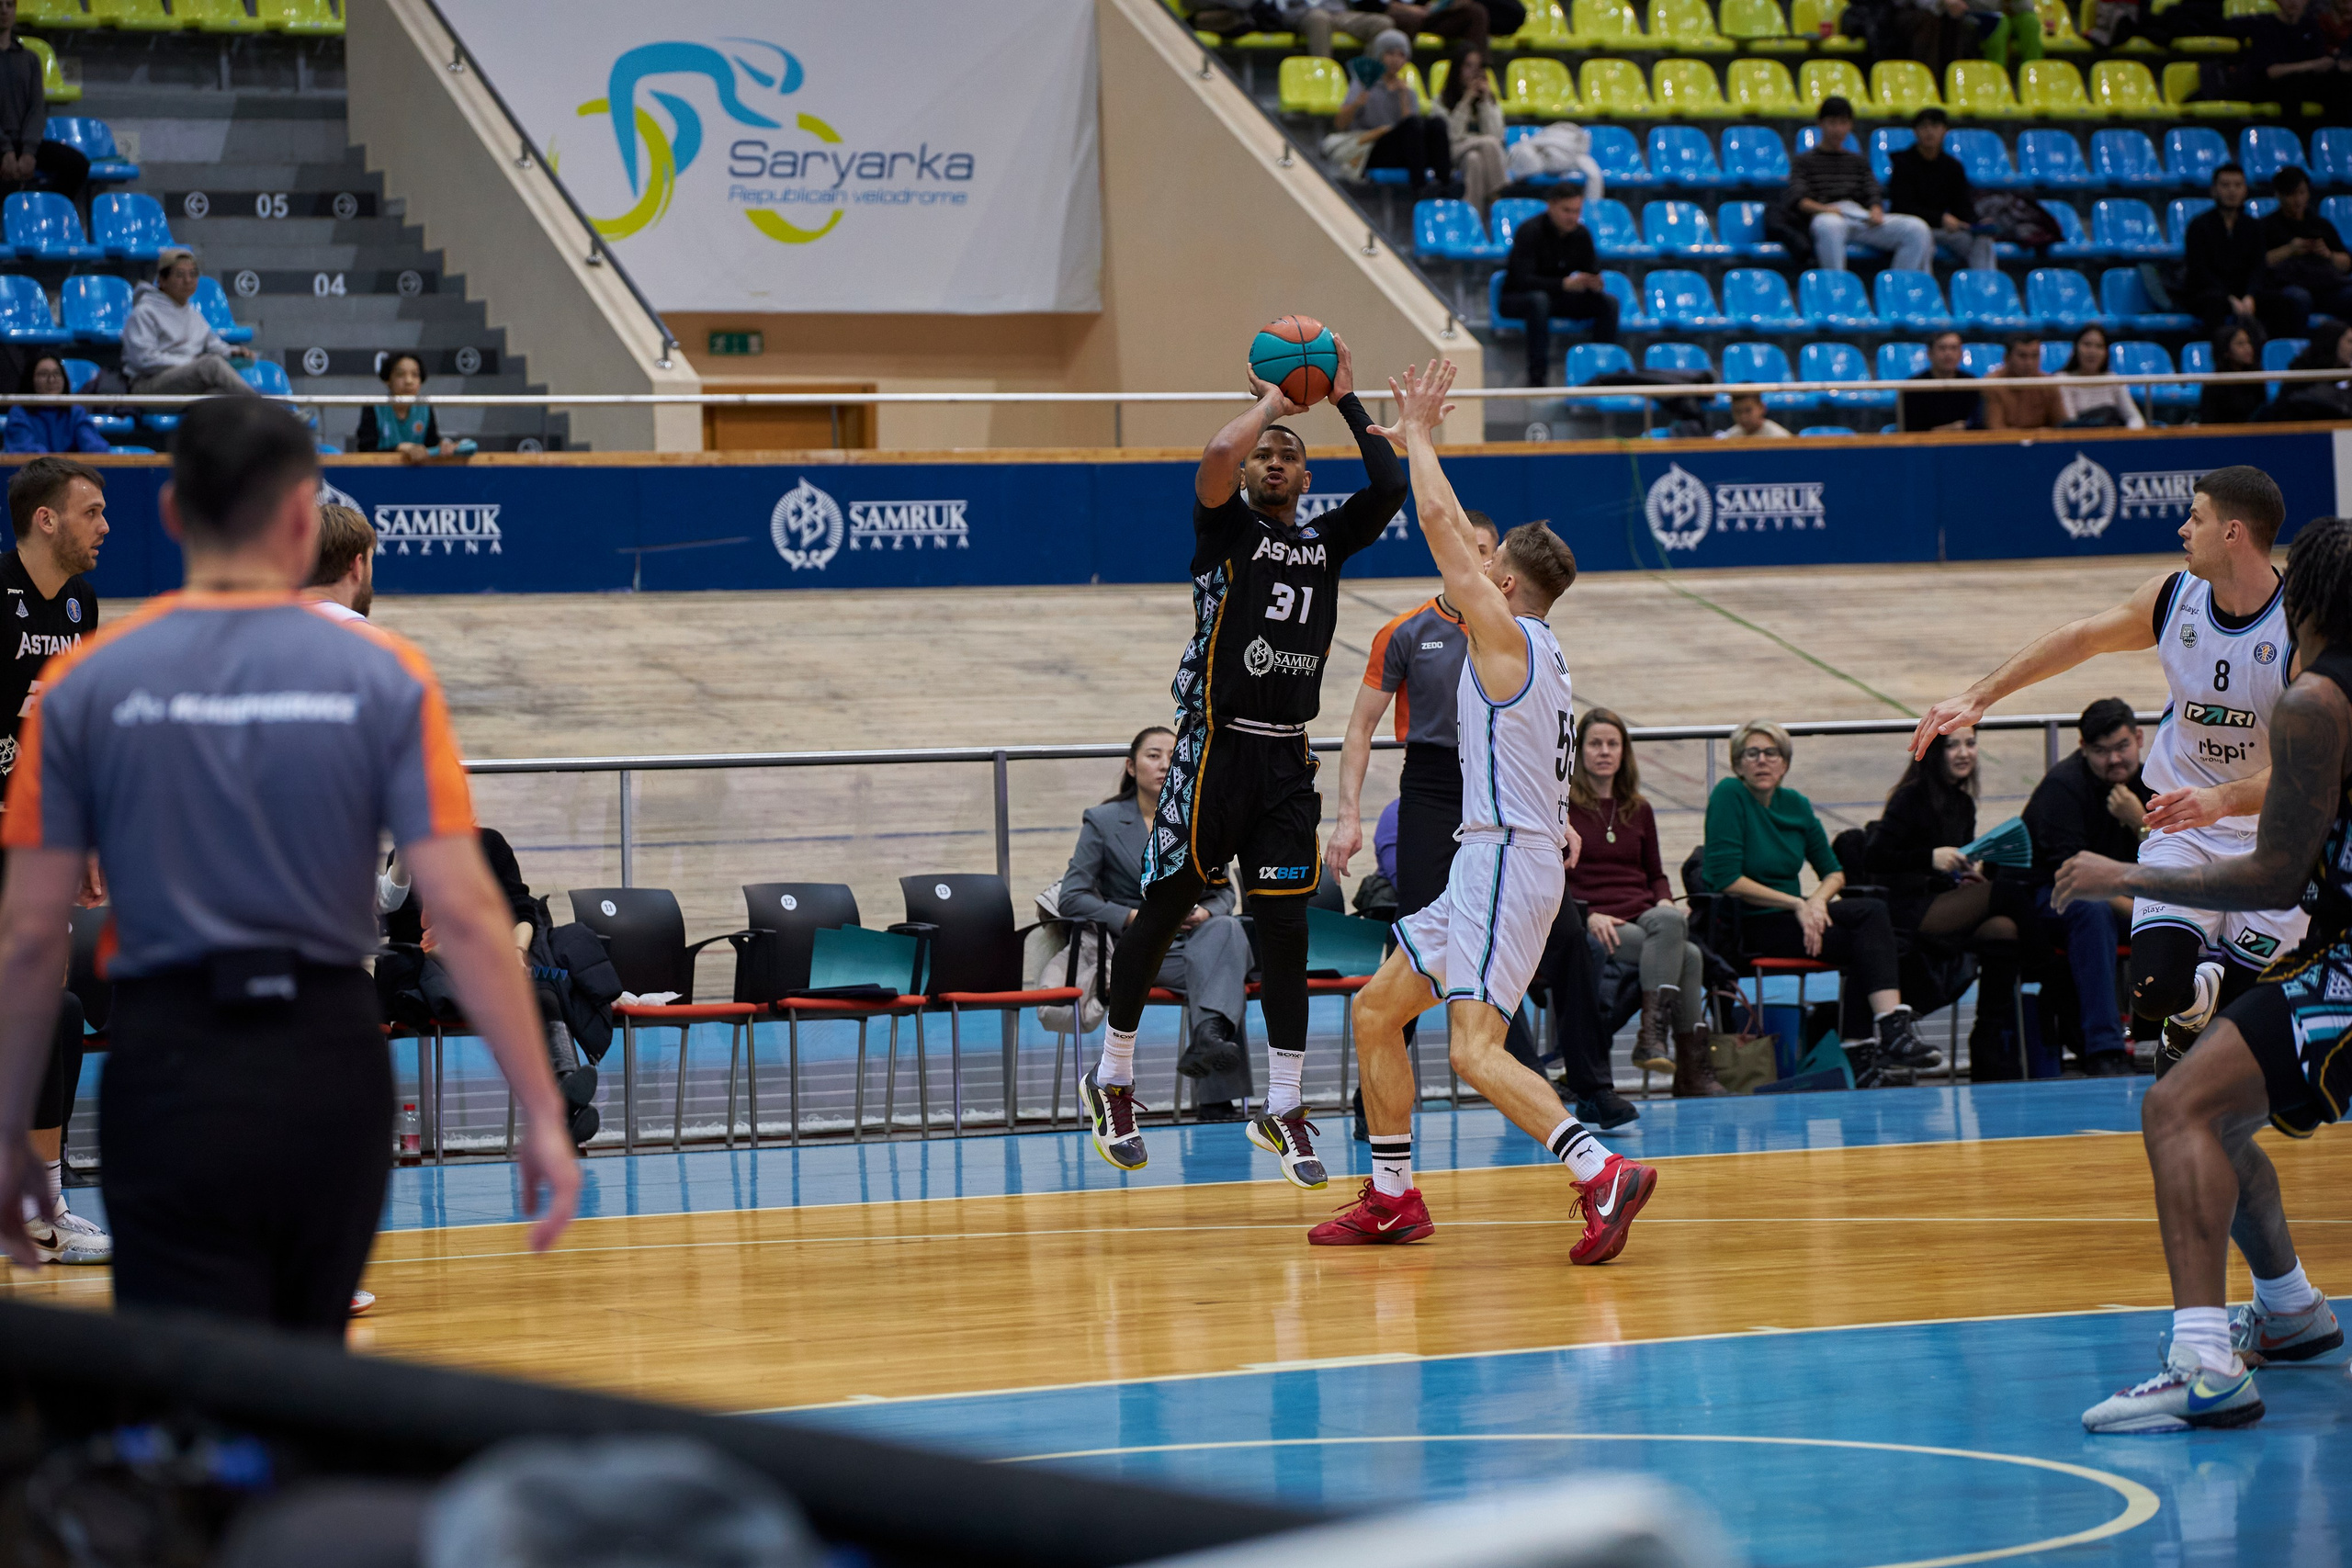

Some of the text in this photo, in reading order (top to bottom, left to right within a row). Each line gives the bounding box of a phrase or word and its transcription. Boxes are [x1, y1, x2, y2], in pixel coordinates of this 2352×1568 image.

[728, 140, 975, 189] Saryarka
[255, 193, 288, 219] 05
[728, 185, 968, 206] Republican velodrome
[312, 272, 347, 298] 04
[1715, 486, 1825, 512] SAMRUK
[374, 509, 502, 536] SAMRUK
[849, 505, 968, 530] SAMRUK
[1716, 515, 1826, 531] KAZYNA
[375, 539, 503, 555] KAZYNA
[850, 534, 970, 550] KAZYNA
[1264, 581, 1314, 625] 31
[15, 631, 83, 660] ASTANA
[1420, 641, 1443, 649] ZEDO
[2213, 659, 2231, 692] 8
[2187, 704, 2255, 727] PARI
[1259, 866, 1309, 880] 1XBET
[783, 897, 795, 906] 12
[937, 886, 948, 896] 13
[604, 903, 614, 912] 11
